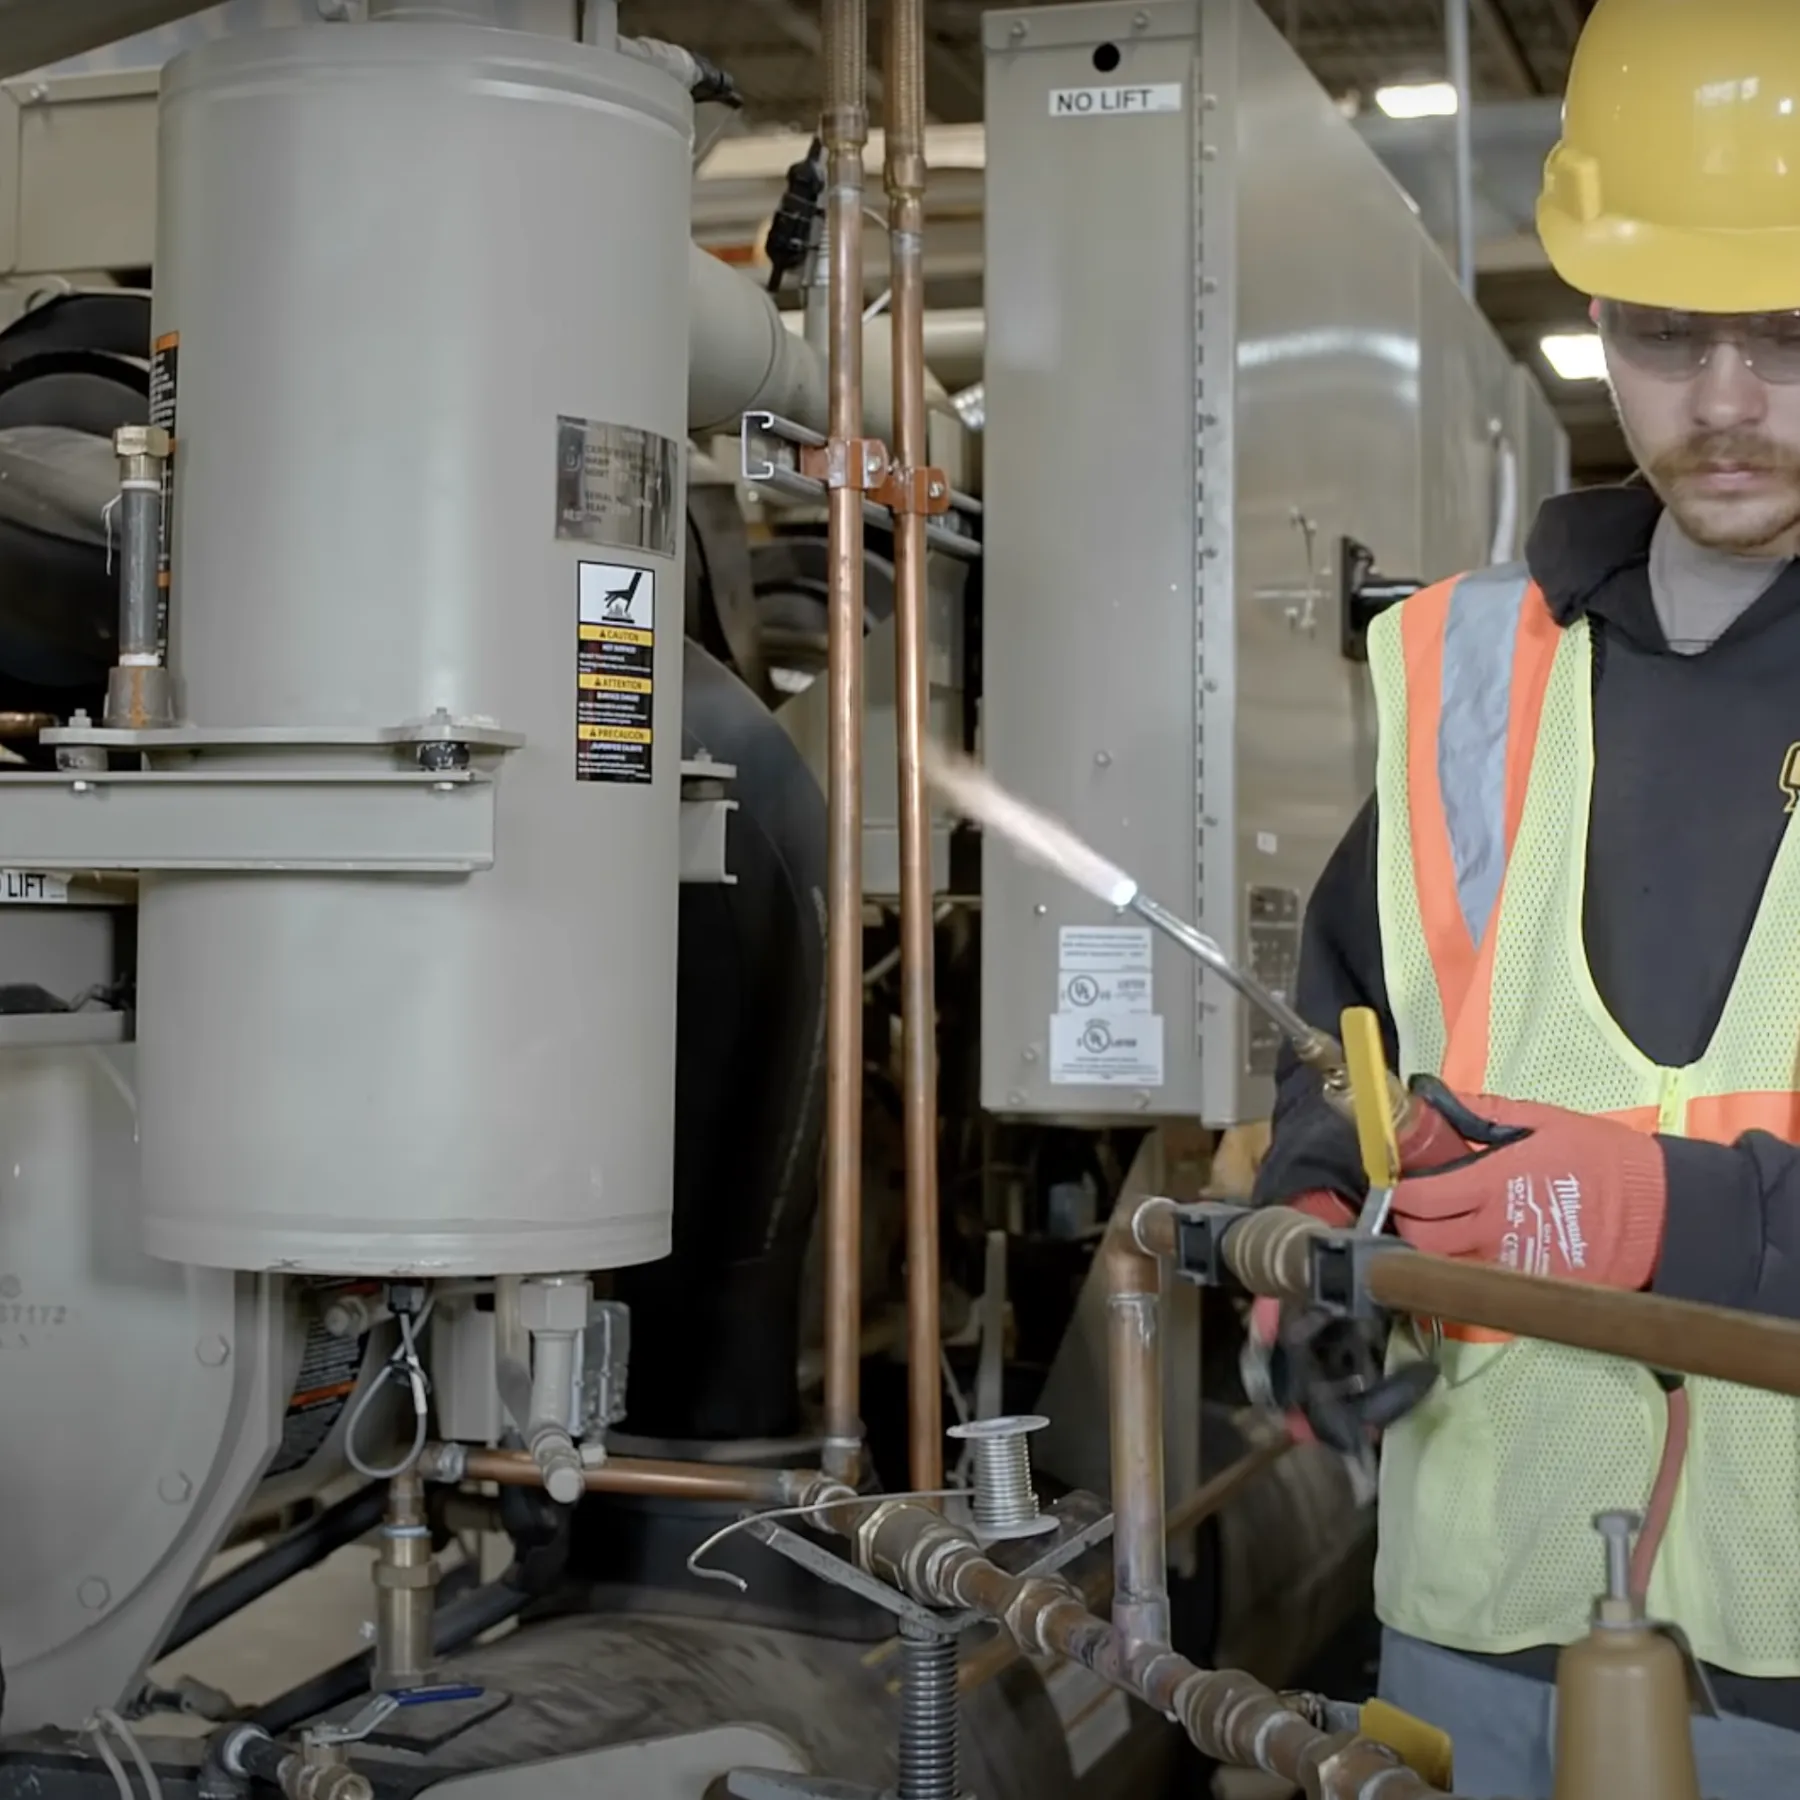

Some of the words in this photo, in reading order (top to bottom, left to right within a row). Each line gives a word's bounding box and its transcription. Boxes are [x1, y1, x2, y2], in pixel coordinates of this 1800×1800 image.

[1057, 91, 1093, 112] NO
[1101, 88, 1154, 110] LIFT
[607, 629, 639, 642] CAUTION
[603, 678, 642, 690] ATTENTION
[8, 873, 46, 898] LIFT
[1553, 1172, 1588, 1268] Milwaukee
